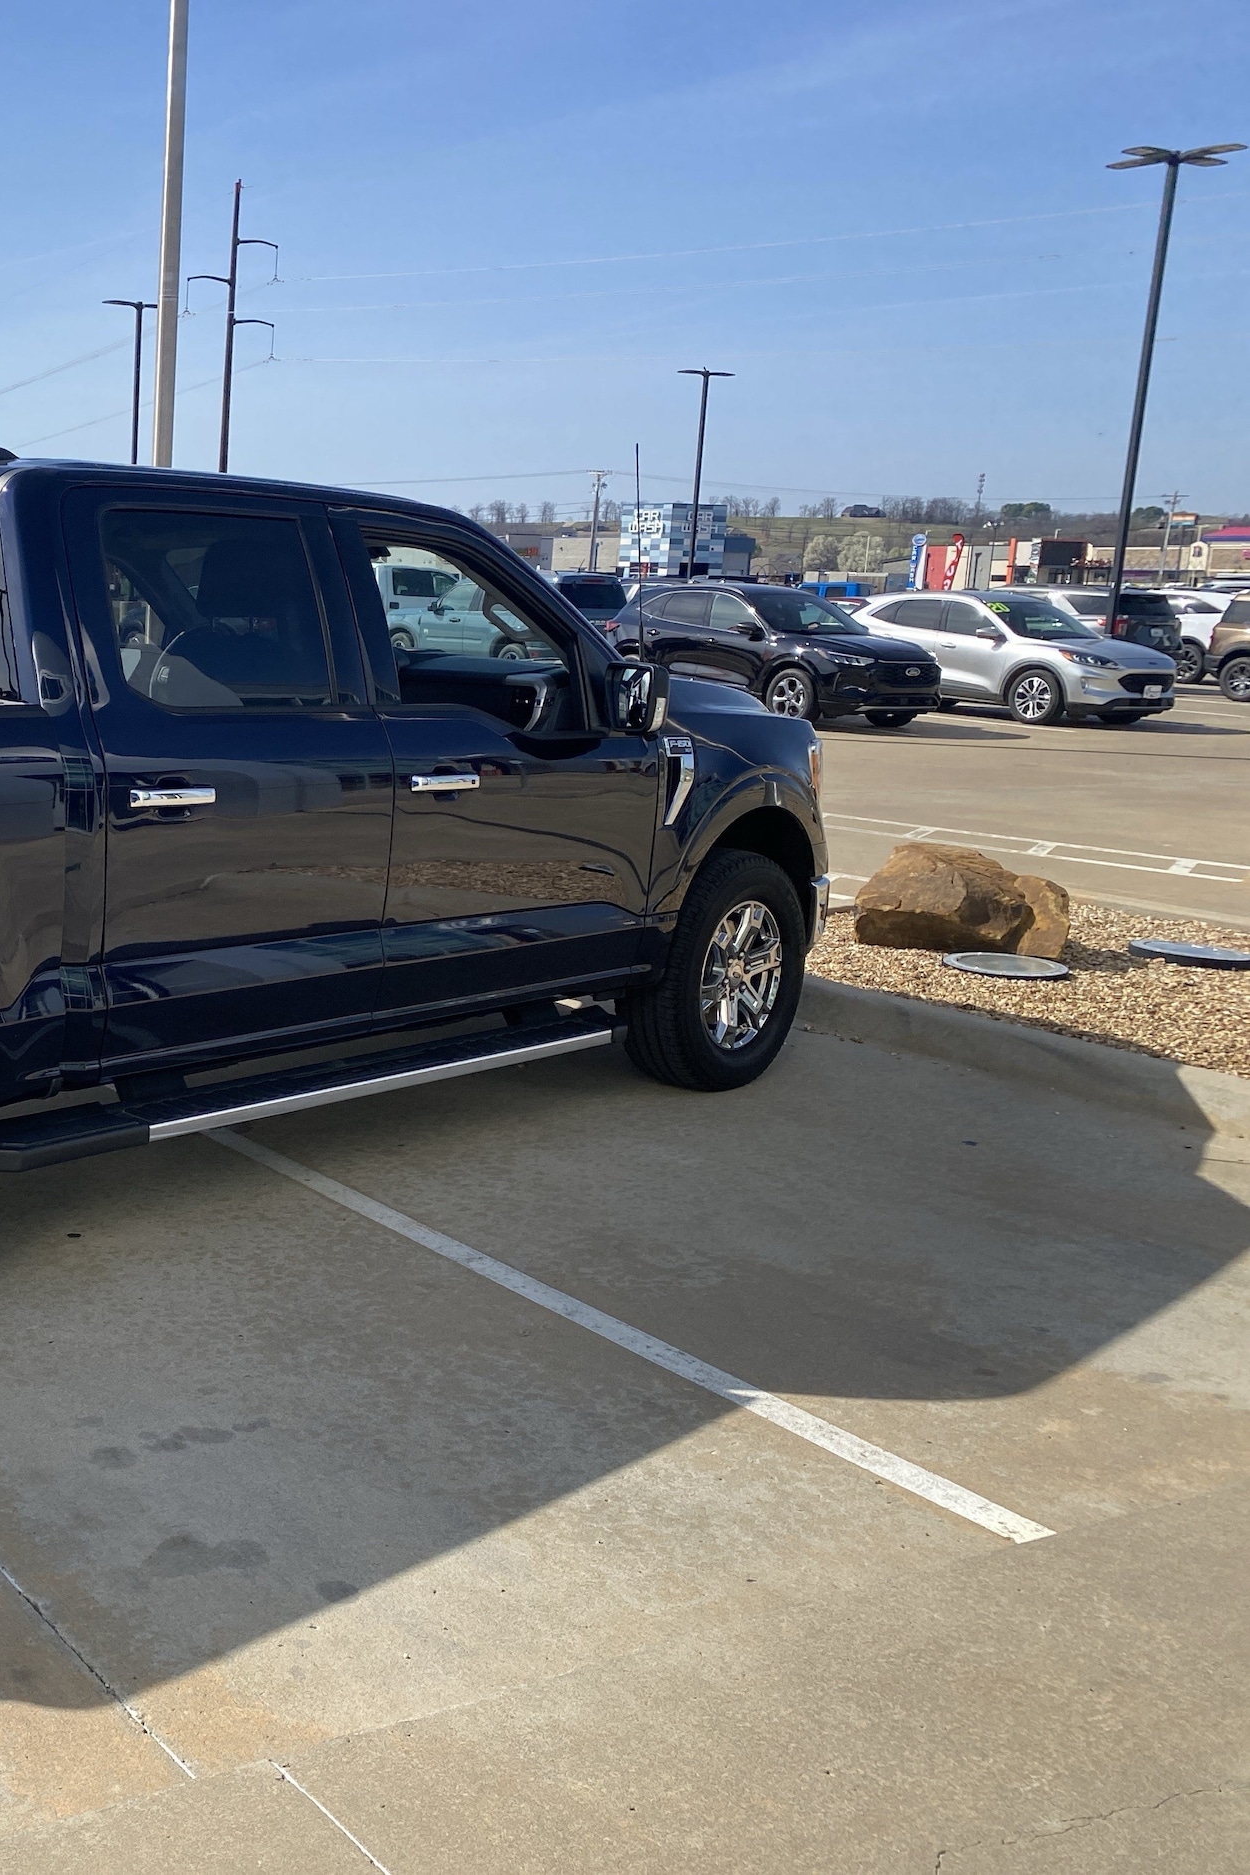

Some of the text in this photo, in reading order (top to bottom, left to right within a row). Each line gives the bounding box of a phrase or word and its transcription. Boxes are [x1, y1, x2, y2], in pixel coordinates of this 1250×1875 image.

[635, 510, 660, 521] CAR
[687, 511, 713, 521] CAR
[628, 522, 664, 534] WASH
[681, 523, 718, 534] WASH
